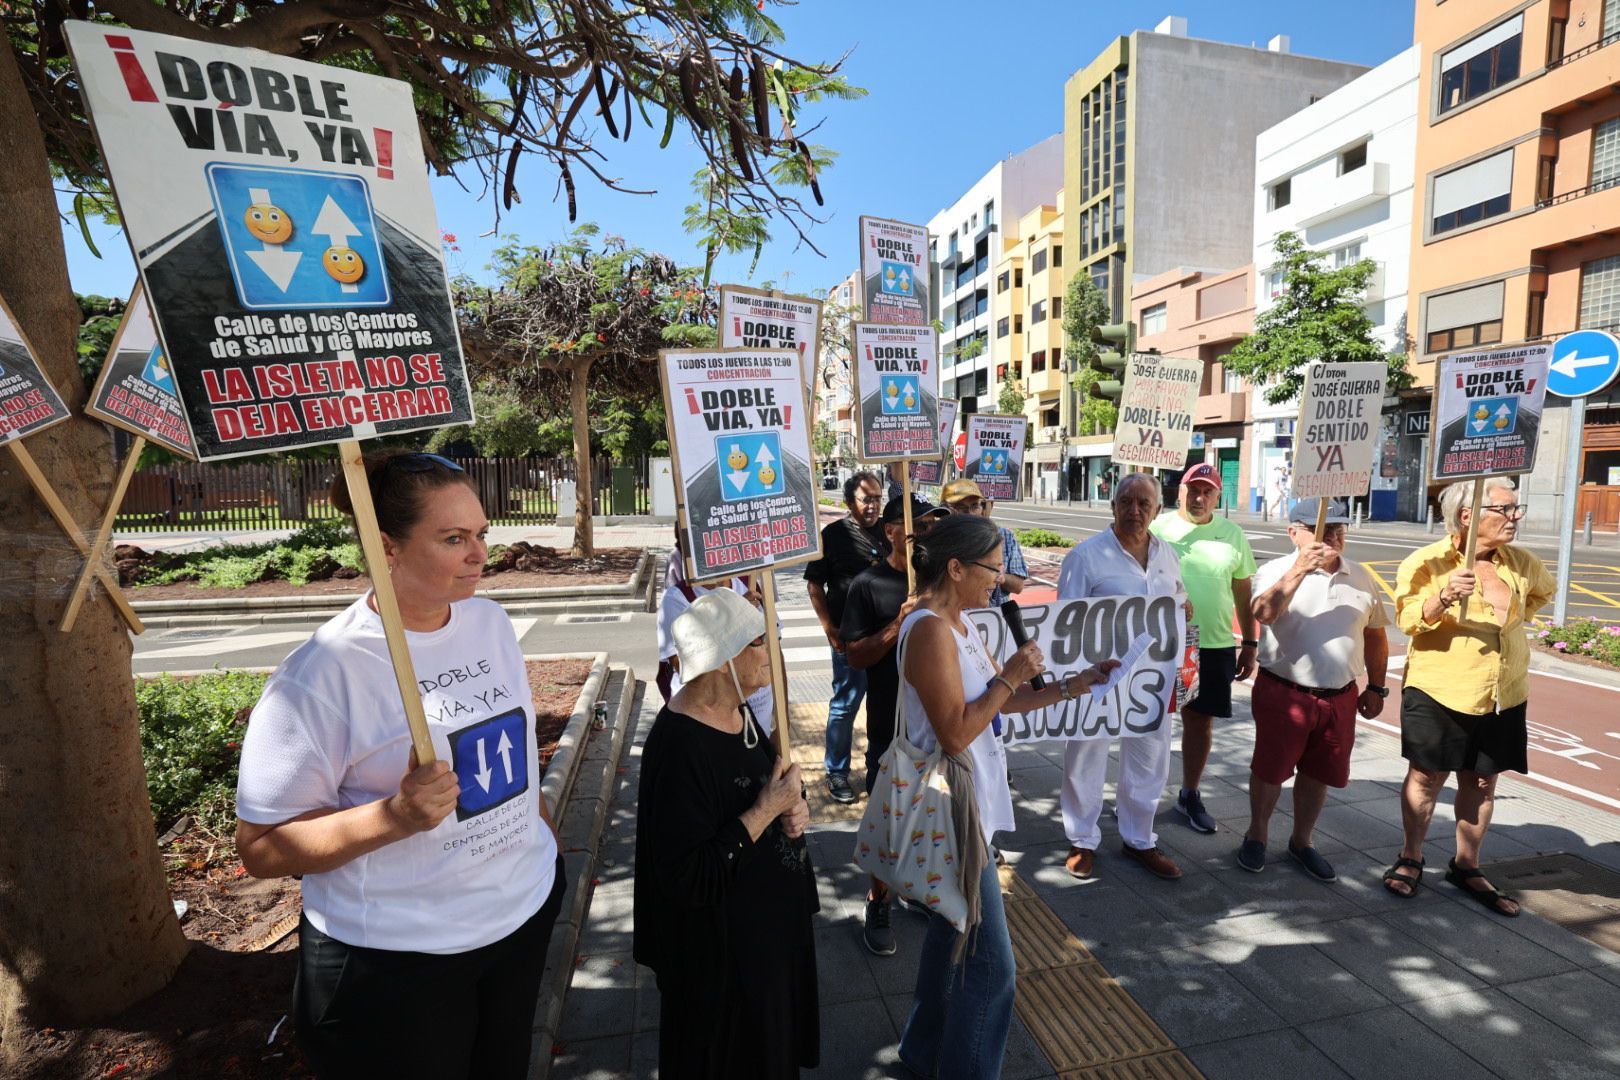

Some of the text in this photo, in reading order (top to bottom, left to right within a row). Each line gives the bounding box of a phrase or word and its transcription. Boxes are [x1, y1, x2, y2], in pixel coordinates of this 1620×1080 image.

[104, 34, 353, 122] ¡DOBLE
[304, 121, 394, 180] YA!
[214, 311, 418, 337] Calle de los Centros
[209, 330, 433, 358] de Salud y de Mayores
[677, 357, 791, 370] TODOS LOS JUEVES A LAS 12:00
[1158, 366, 1197, 382] GUERRA
[0, 380, 32, 397] ayores
[201, 353, 446, 404] LA ISLETA NO SE
[1340, 379, 1380, 396] GUERRA
[1505, 379, 1537, 395] YA!
[2, 396, 27, 415] NO
[24, 388, 45, 406] SE
[105, 396, 136, 420] DEJA
[111, 385, 128, 402] LA
[127, 392, 166, 420] ISLETA
[164, 412, 181, 429] NO
[211, 386, 453, 442] DEJA ENCERRAR
[1316, 399, 1364, 420] DOBLE
[0, 403, 55, 434] CERRAR
[757, 405, 792, 430] YA!
[1139, 428, 1163, 448] YA
[1305, 419, 1369, 444] SENTIDO
[1459, 449, 1494, 462] ISLETA
[1512, 446, 1526, 458] SE
[708, 503, 802, 527] de Salud y de Mayores
[710, 495, 796, 517] Calle de los Centros
[703, 515, 806, 549] LA ISLETA NO SE
[705, 532, 808, 568] DEJA ENCERRAR
[1051, 596, 1179, 667] 9000
[419, 660, 491, 693] DOBLE
[474, 685, 512, 711] YA!
[466, 809, 500, 830] CALLE
[443, 826, 498, 851] CENTROS
[471, 845, 486, 856] DE
